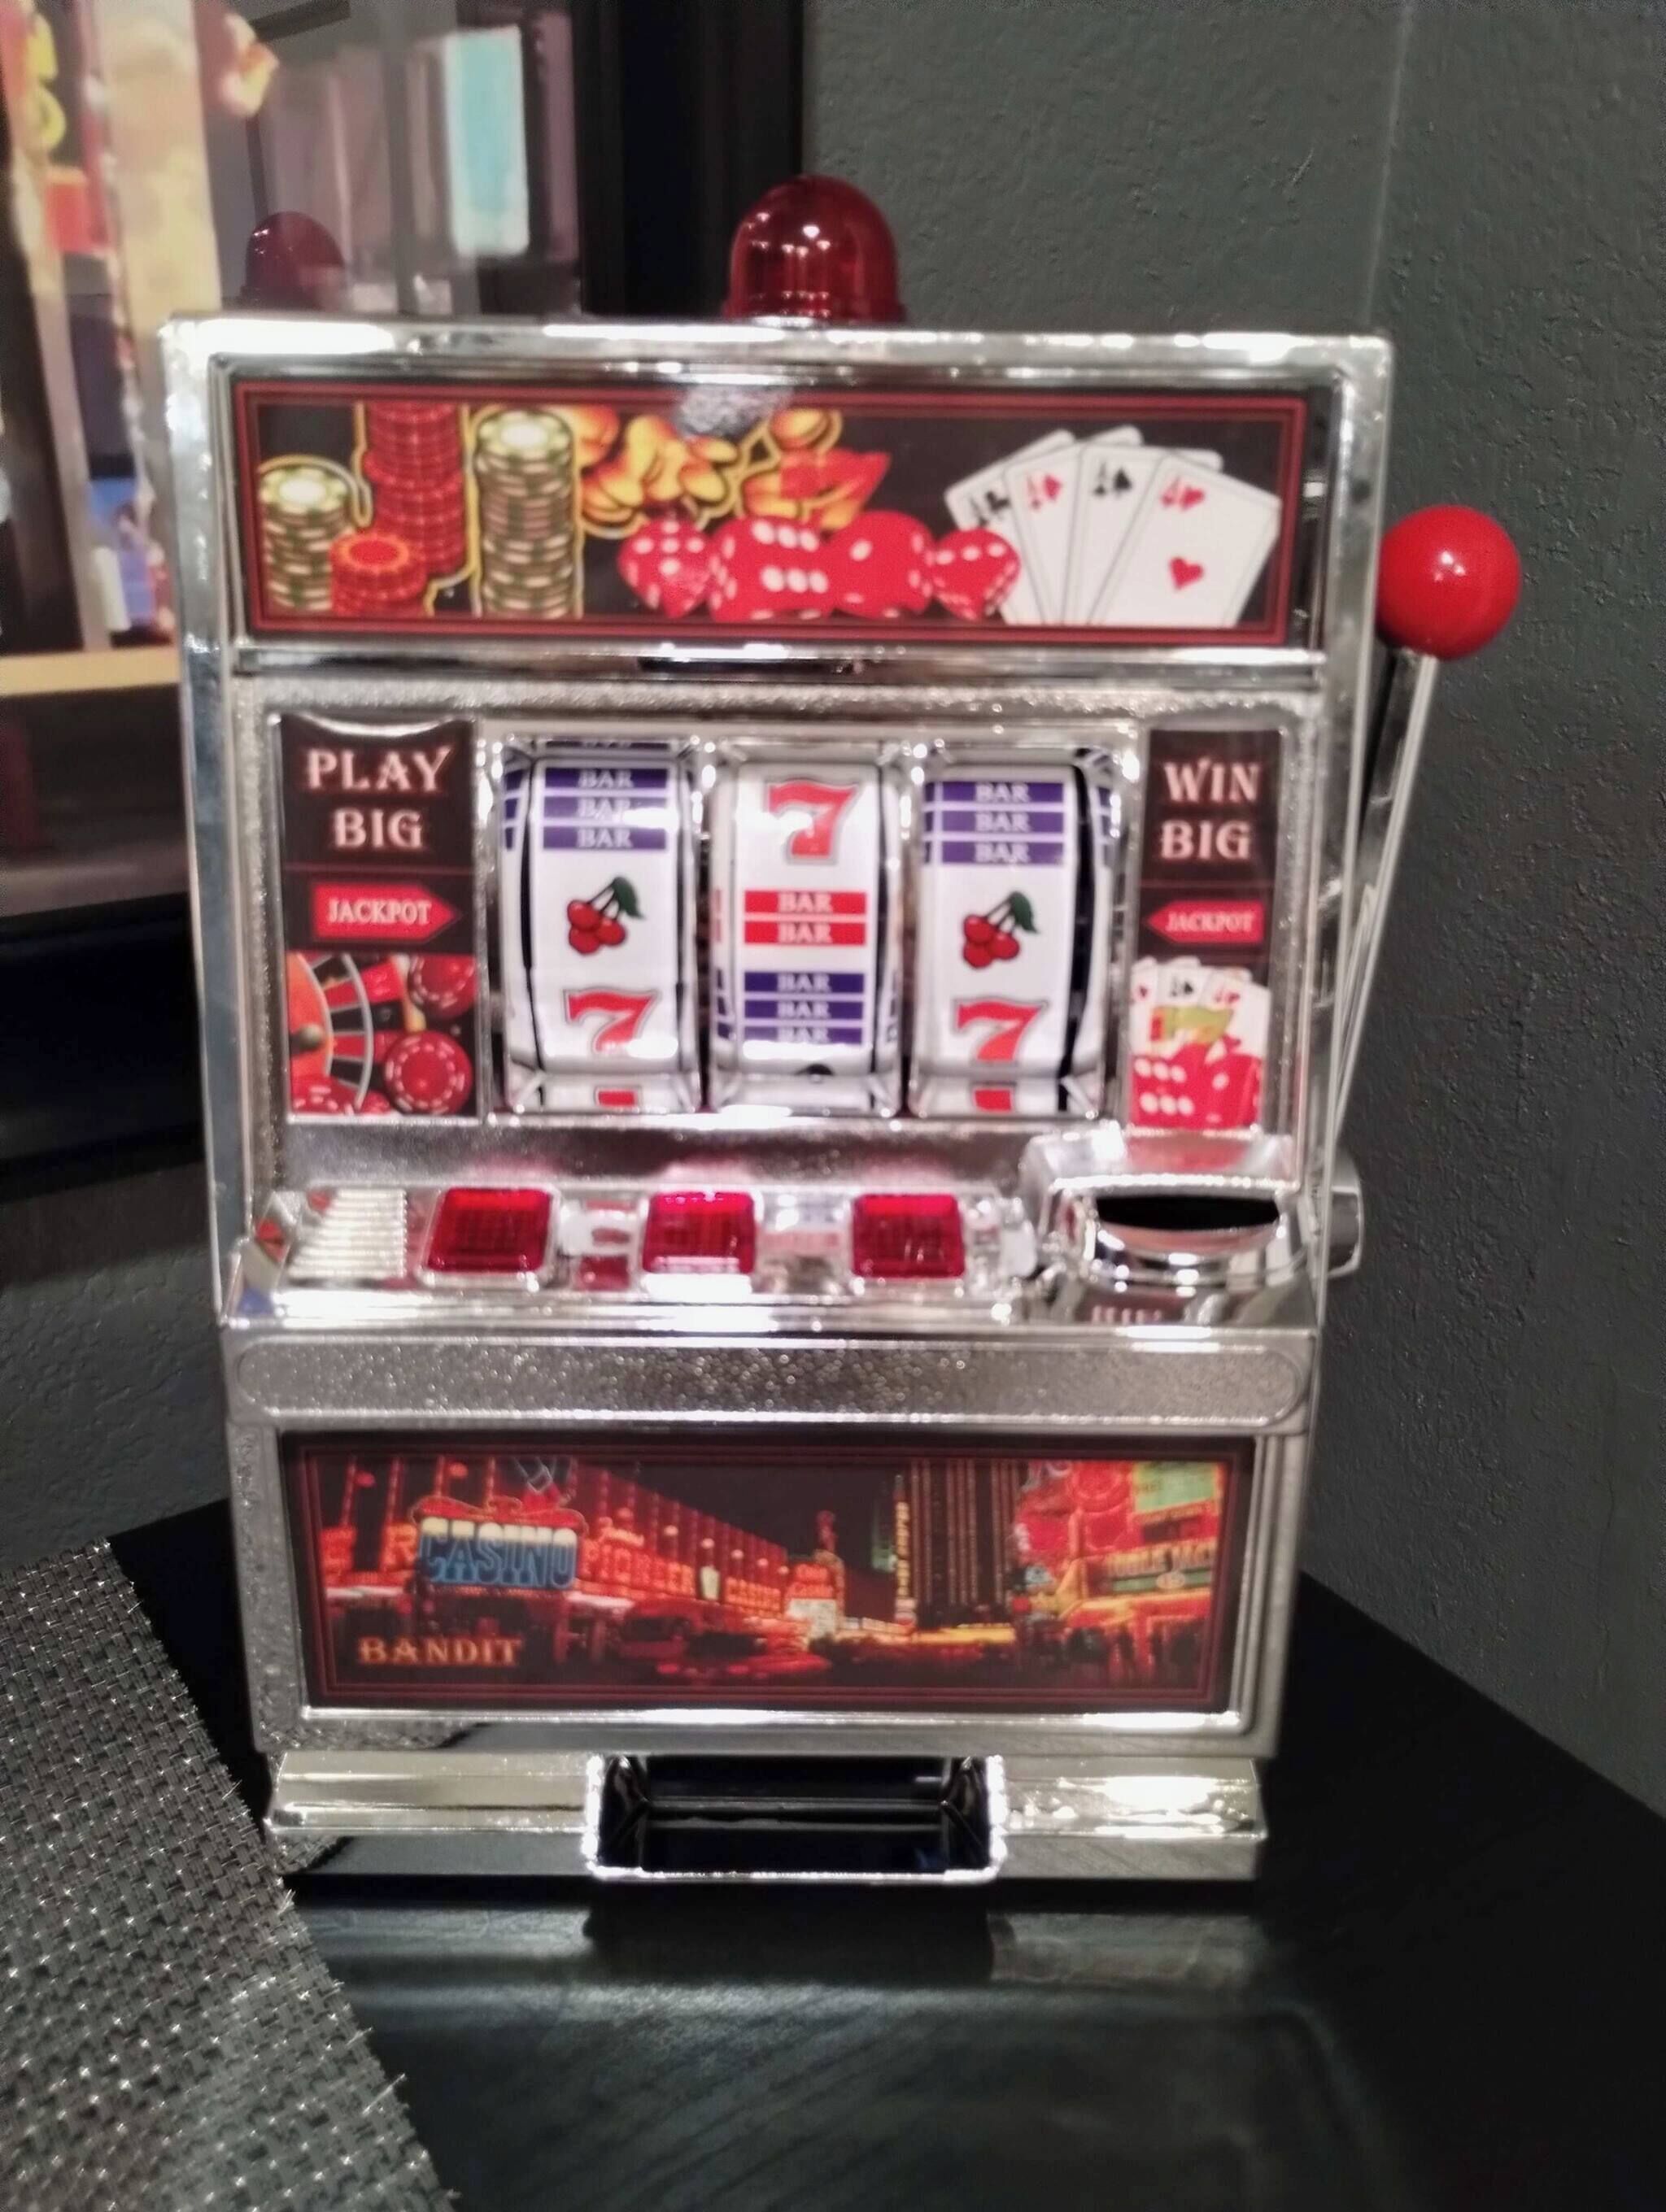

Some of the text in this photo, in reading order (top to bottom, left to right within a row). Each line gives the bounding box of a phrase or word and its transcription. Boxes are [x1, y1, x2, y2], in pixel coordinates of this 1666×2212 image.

[307, 745, 452, 793] PLAY
[577, 769, 635, 789] BAR
[1163, 757, 1259, 803] WIN
[975, 782, 1031, 803] BAR
[334, 808, 422, 848] BIG
[765, 777, 860, 866] 7
[975, 811, 1031, 834] BAR
[576, 828, 635, 848] BAR
[1160, 819, 1250, 860] BIG
[975, 842, 1031, 865] BAR
[328, 897, 432, 925] JACKPOT
[777, 891, 833, 913] BAR
[777, 921, 833, 945] BAR
[1165, 909, 1255, 934] JACKPOT
[777, 972, 833, 994] BAR
[563, 986, 662, 1052] 7
[777, 1001, 833, 1020] BAR
[952, 996, 1048, 1064] 7
[419, 1517, 577, 1590] CASINO
[358, 1635, 522, 1666] BANDIT
